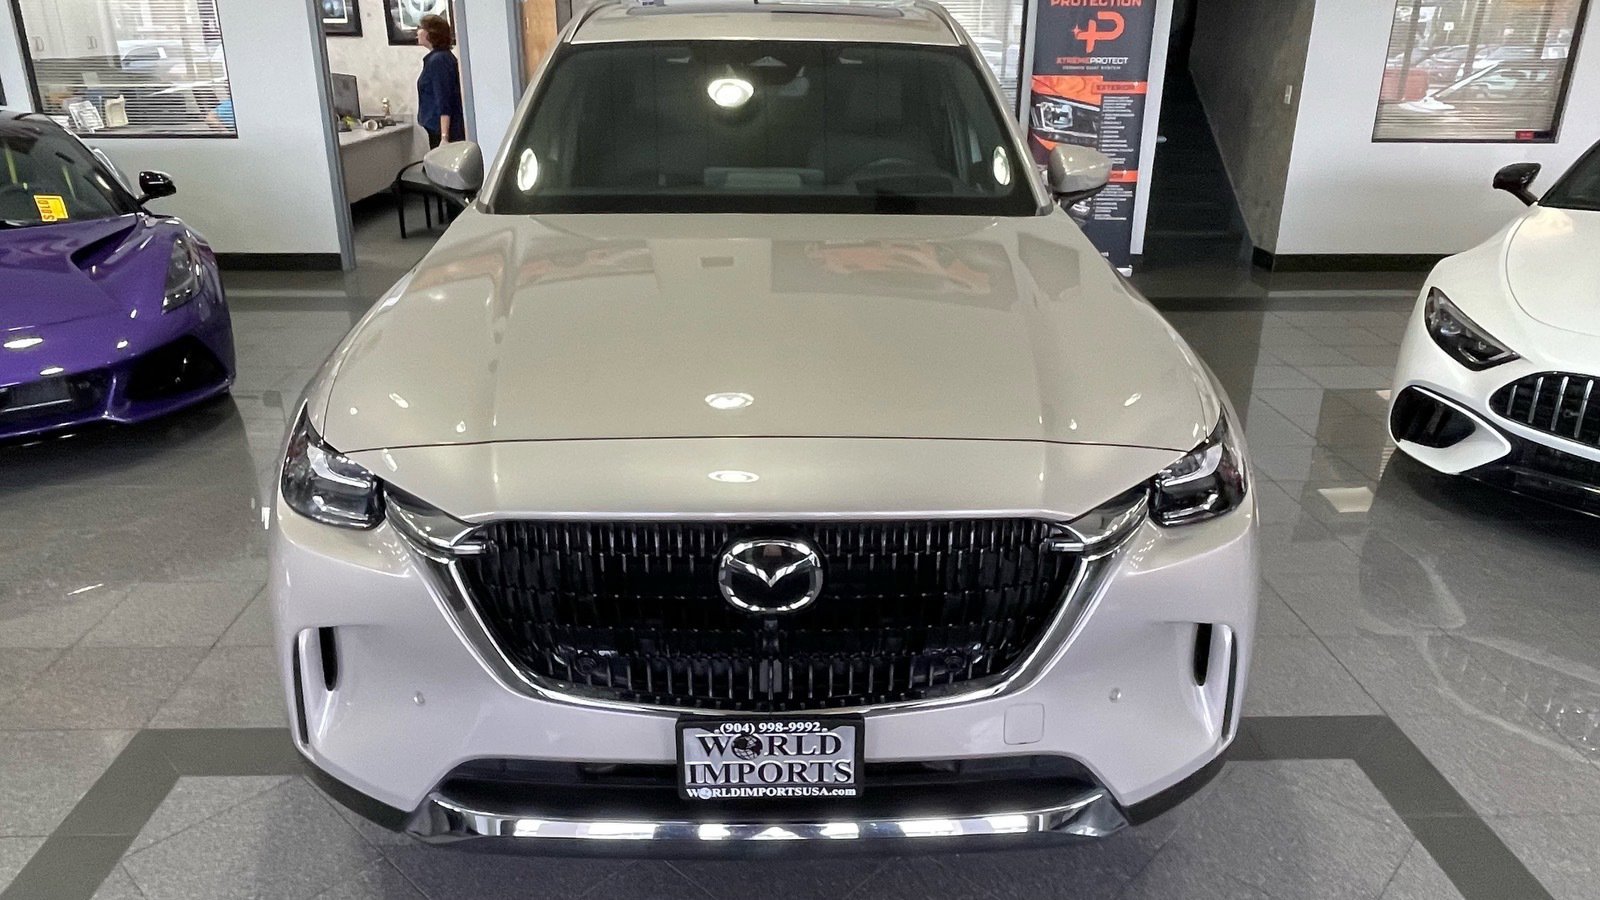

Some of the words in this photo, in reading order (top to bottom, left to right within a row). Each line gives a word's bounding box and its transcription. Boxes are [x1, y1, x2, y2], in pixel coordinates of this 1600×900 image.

[37, 199, 55, 220] SOLD
[720, 722, 755, 735] (904)
[758, 721, 821, 733] 998-9992
[695, 733, 842, 760] WORLD
[685, 760, 852, 784] IMPORTS
[686, 787, 857, 799] WORLDIMPORTSUSA.com
